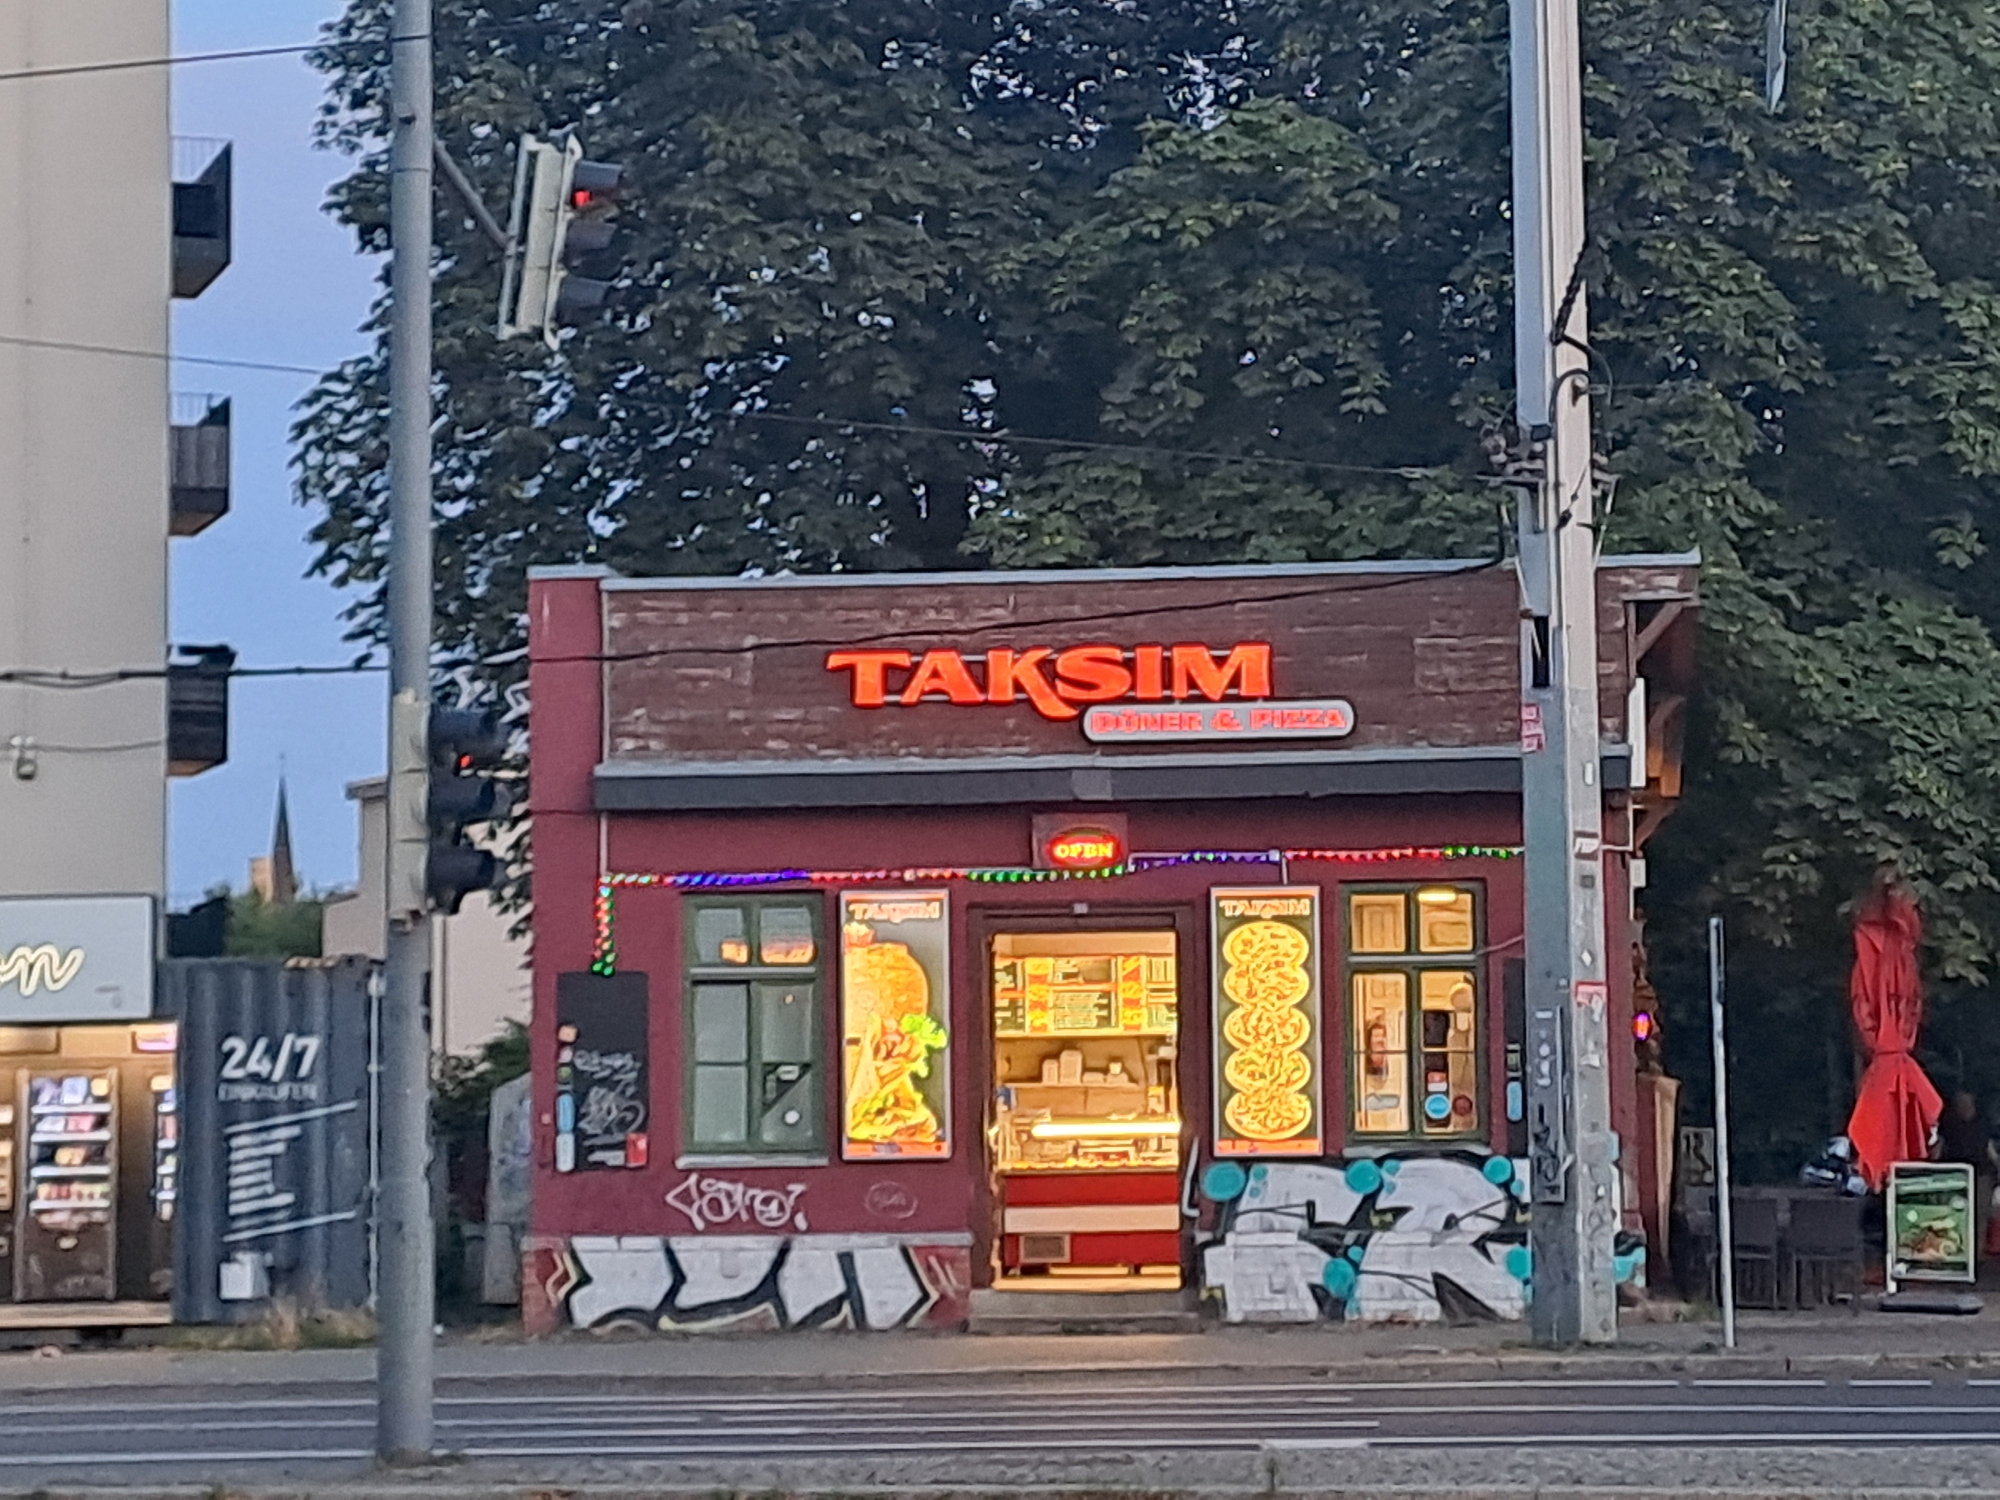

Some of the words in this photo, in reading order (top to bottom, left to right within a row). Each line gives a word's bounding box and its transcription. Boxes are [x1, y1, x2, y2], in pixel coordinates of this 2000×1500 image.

[826, 643, 1271, 721] TAKSIM
[1091, 709, 1203, 733] DÖNER
[1210, 708, 1243, 731] &
[1250, 708, 1346, 729] PIZZA
[1053, 842, 1114, 859] OPEN
[221, 1033, 320, 1082] 24/7
